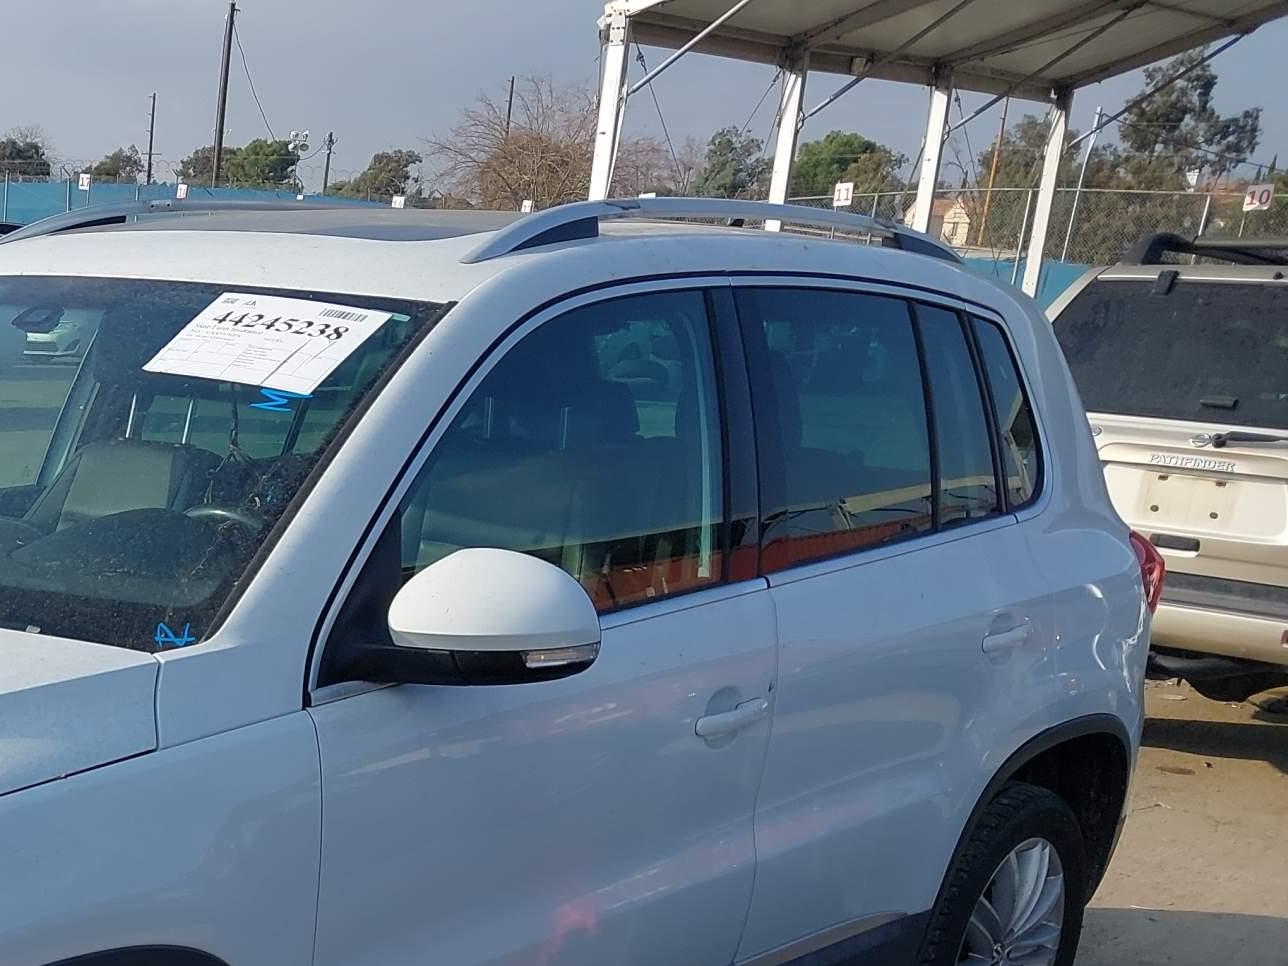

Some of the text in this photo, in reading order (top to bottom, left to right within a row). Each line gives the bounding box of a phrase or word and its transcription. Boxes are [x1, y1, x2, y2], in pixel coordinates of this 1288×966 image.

[835, 188, 850, 202] 11
[1246, 189, 1271, 206] 10
[213, 311, 350, 340] 44245238
[1149, 453, 1237, 472] PATHFINDER
